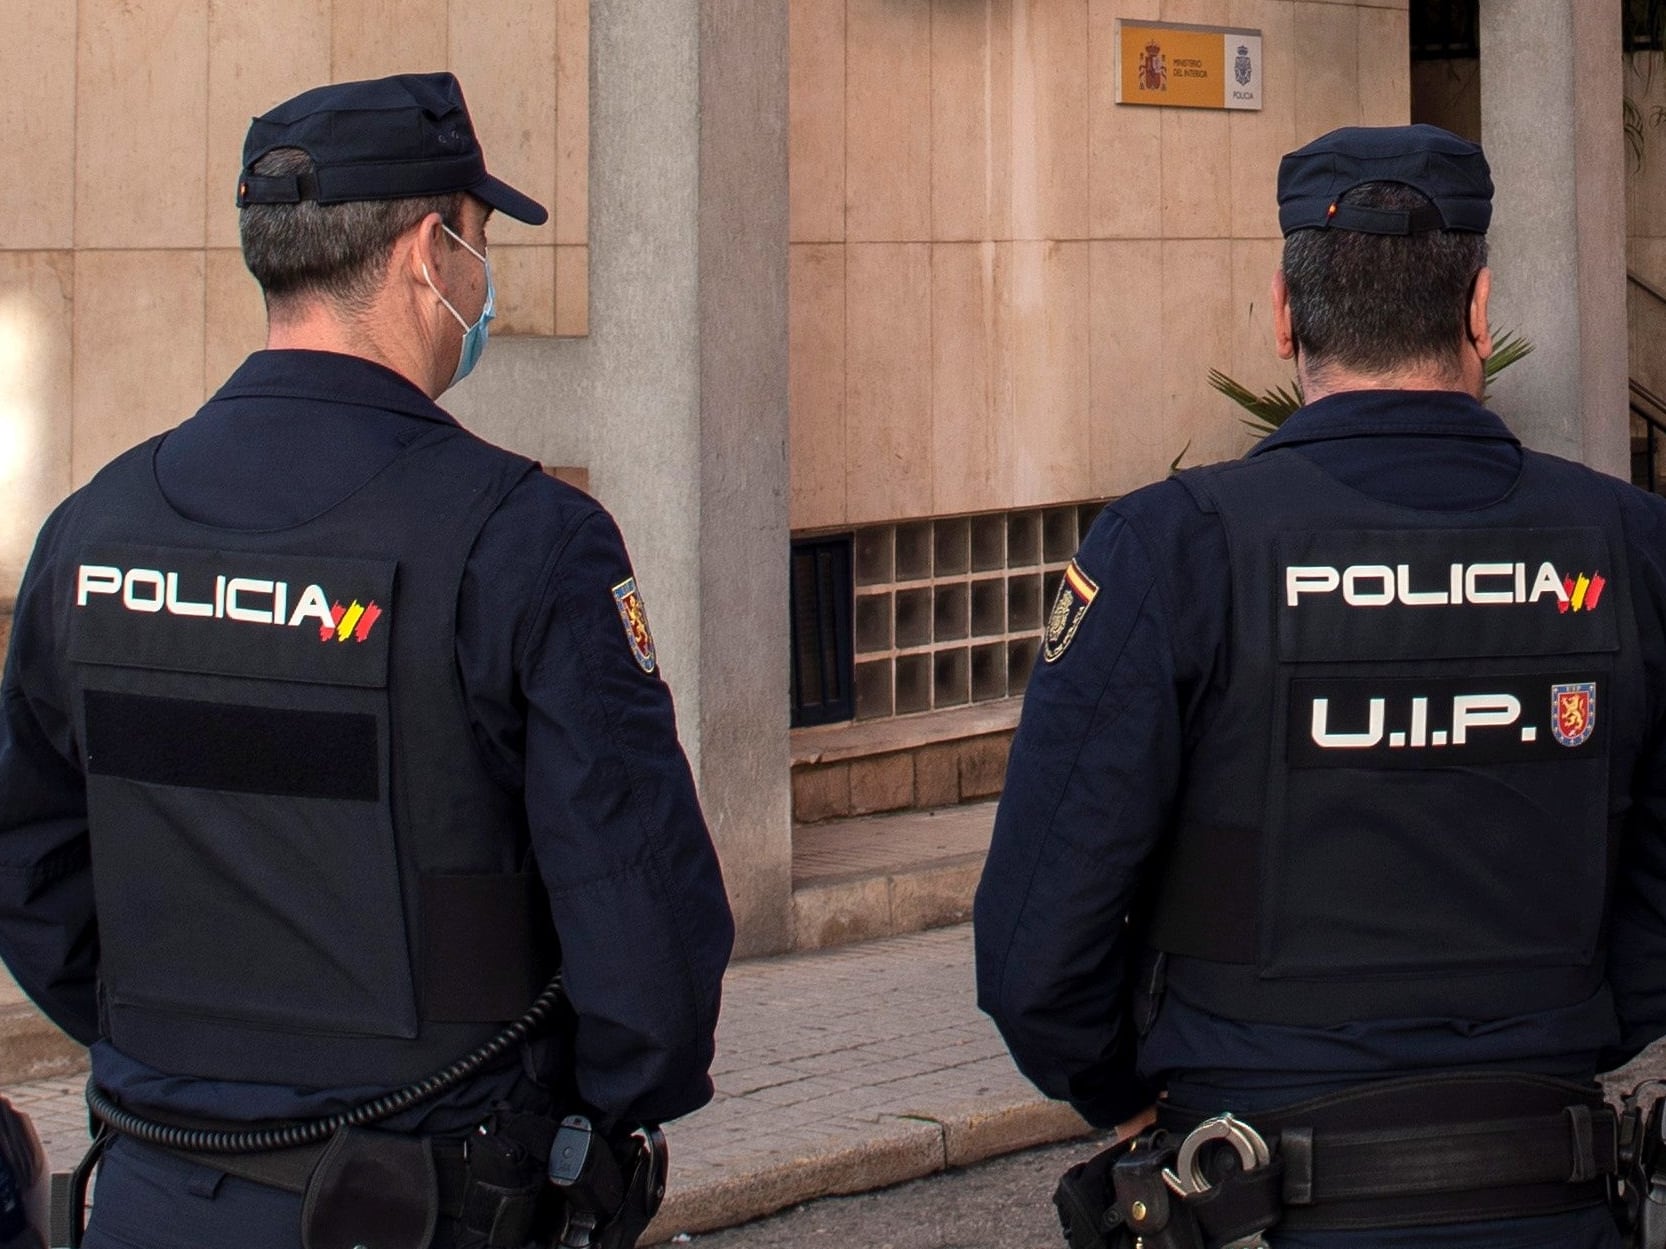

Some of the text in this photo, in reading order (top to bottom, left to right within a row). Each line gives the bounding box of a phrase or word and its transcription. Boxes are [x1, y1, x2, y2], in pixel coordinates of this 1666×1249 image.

[1173, 59, 1201, 67] MINISTERIO
[1173, 68, 1208, 78] DEL INTERIOR
[77, 564, 335, 629] POLICIA
[1286, 561, 1570, 606] POLICIA
[1311, 694, 1537, 747] U.I.P.
